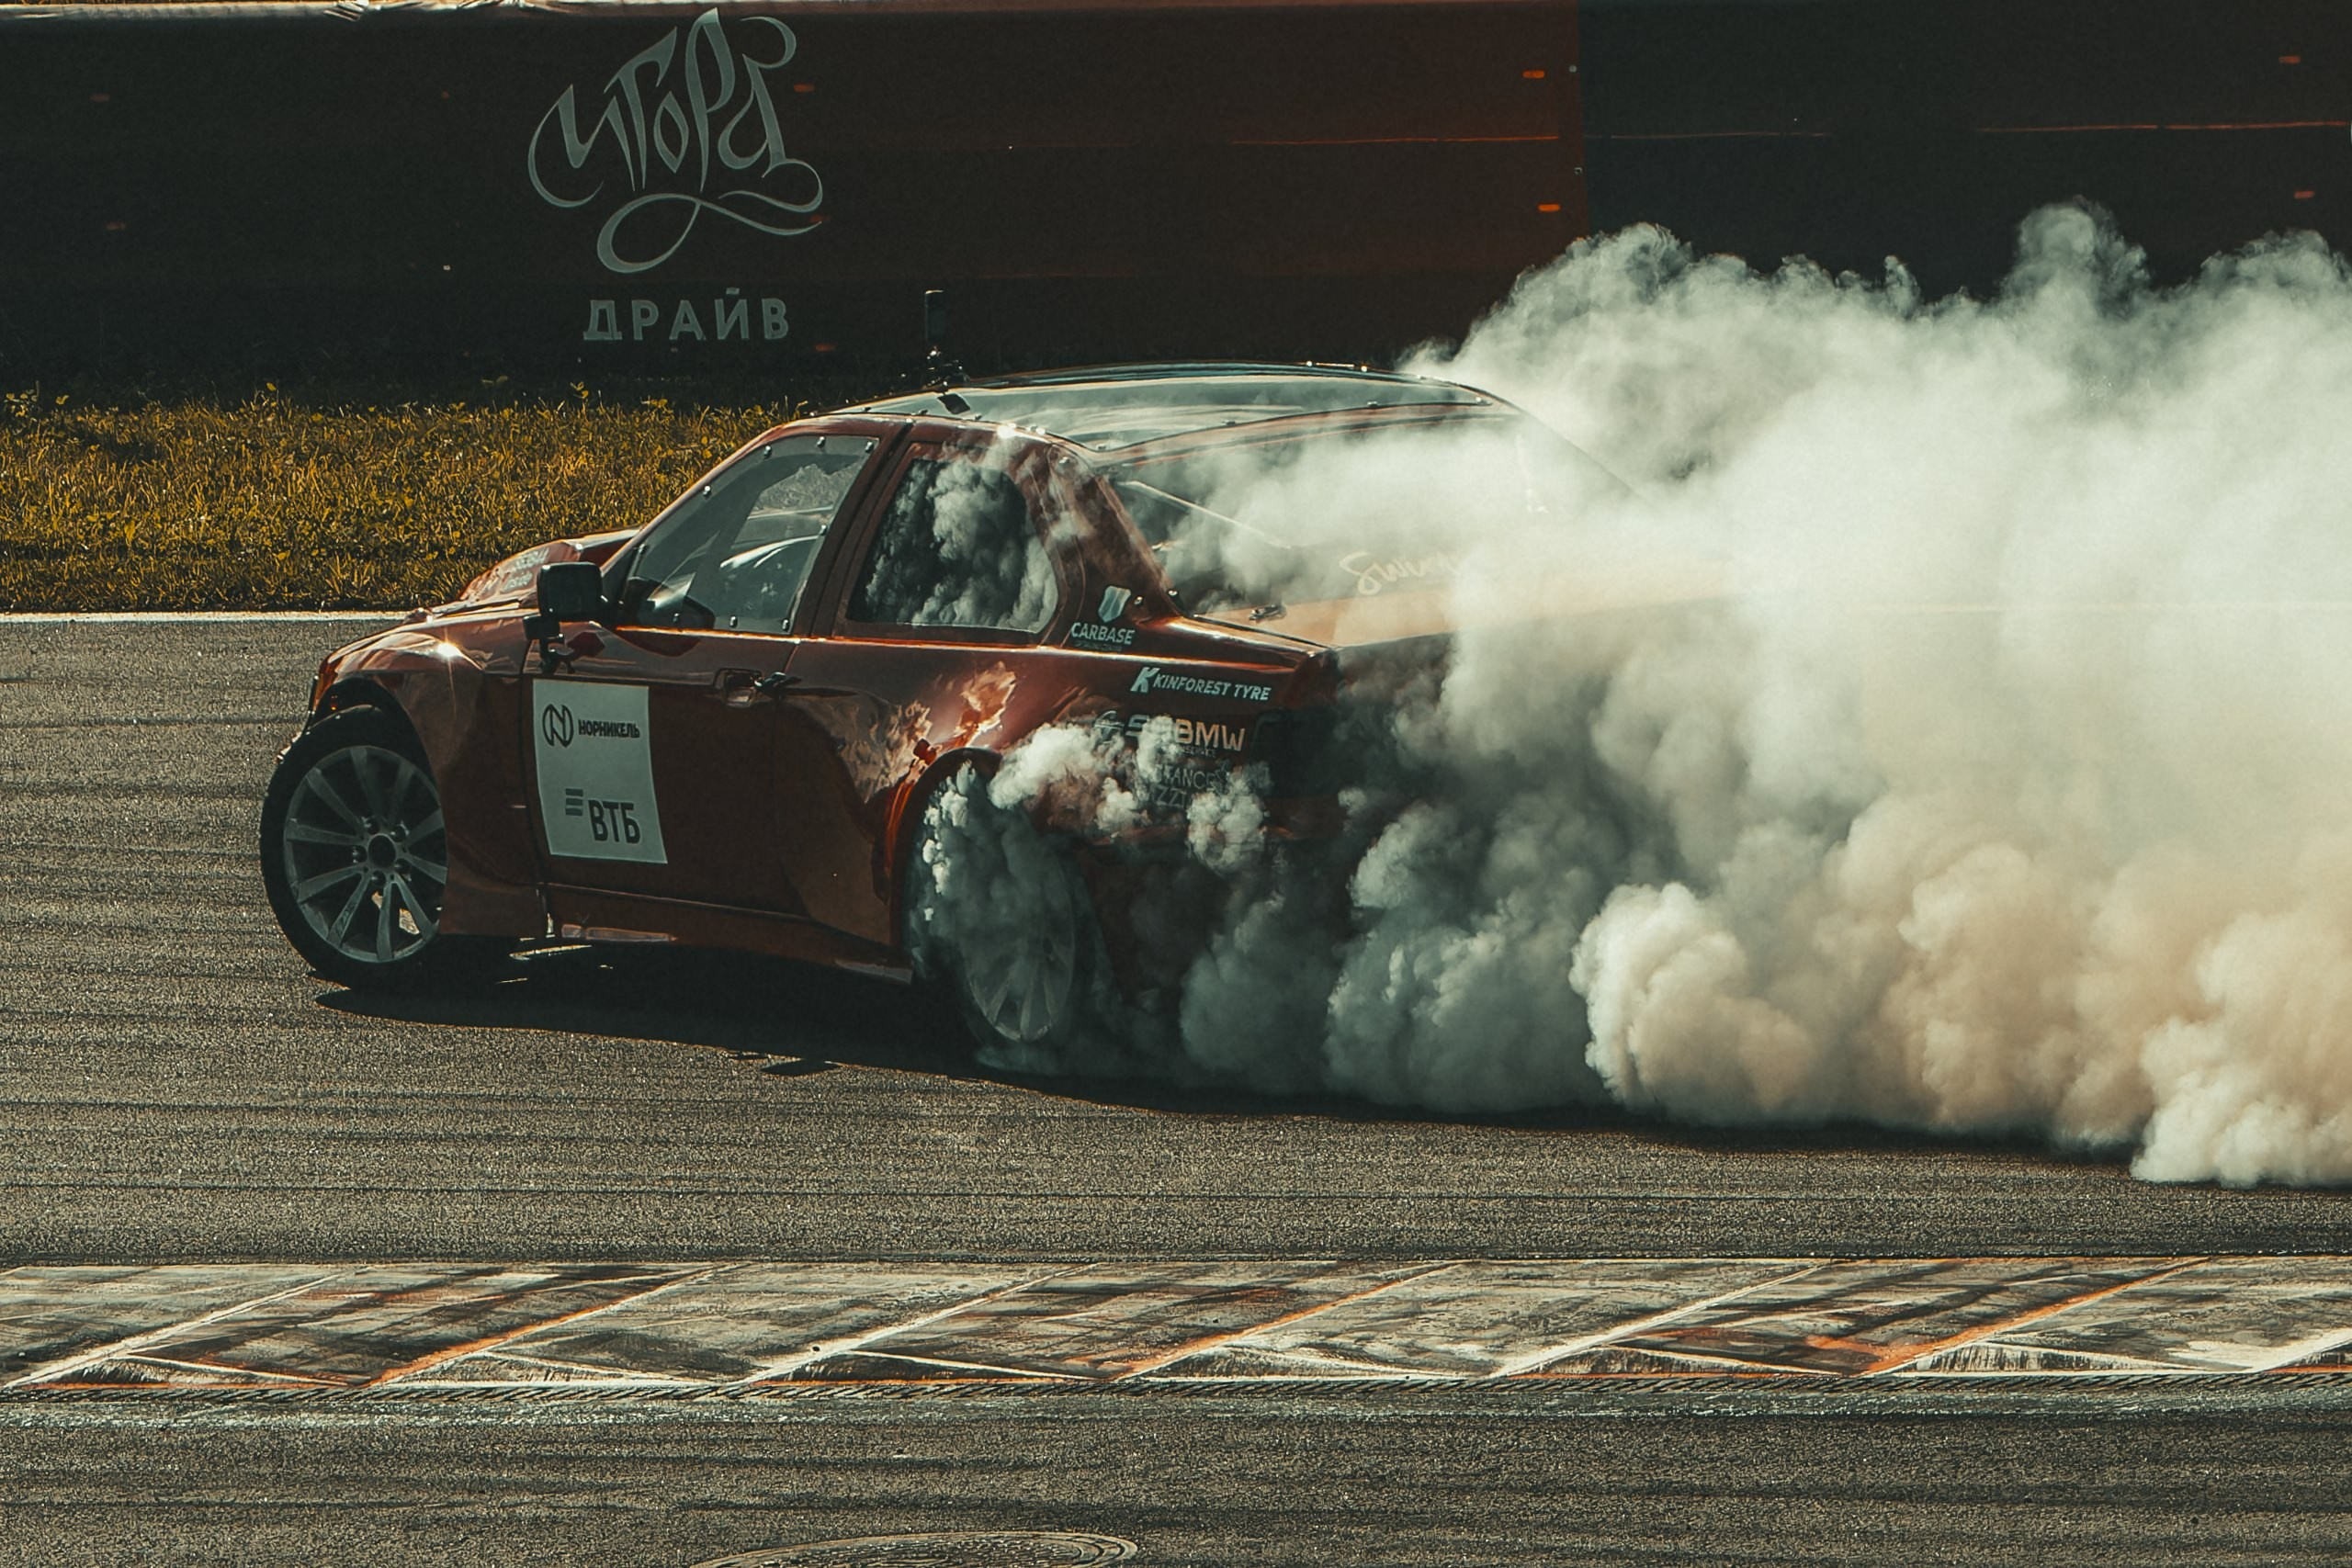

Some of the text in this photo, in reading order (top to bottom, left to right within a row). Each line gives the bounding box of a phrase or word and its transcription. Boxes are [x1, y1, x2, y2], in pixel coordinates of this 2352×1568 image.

[583, 287, 789, 341] ДРАЙВ
[1070, 622, 1136, 646] CARBASE
[1152, 673, 1231, 696] KINFOREST
[1234, 684, 1272, 701] TYRE
[578, 719, 640, 739] НОРНИКЕЛЬ
[1175, 718, 1246, 752] BMW
[588, 799, 641, 844] ВТБ
